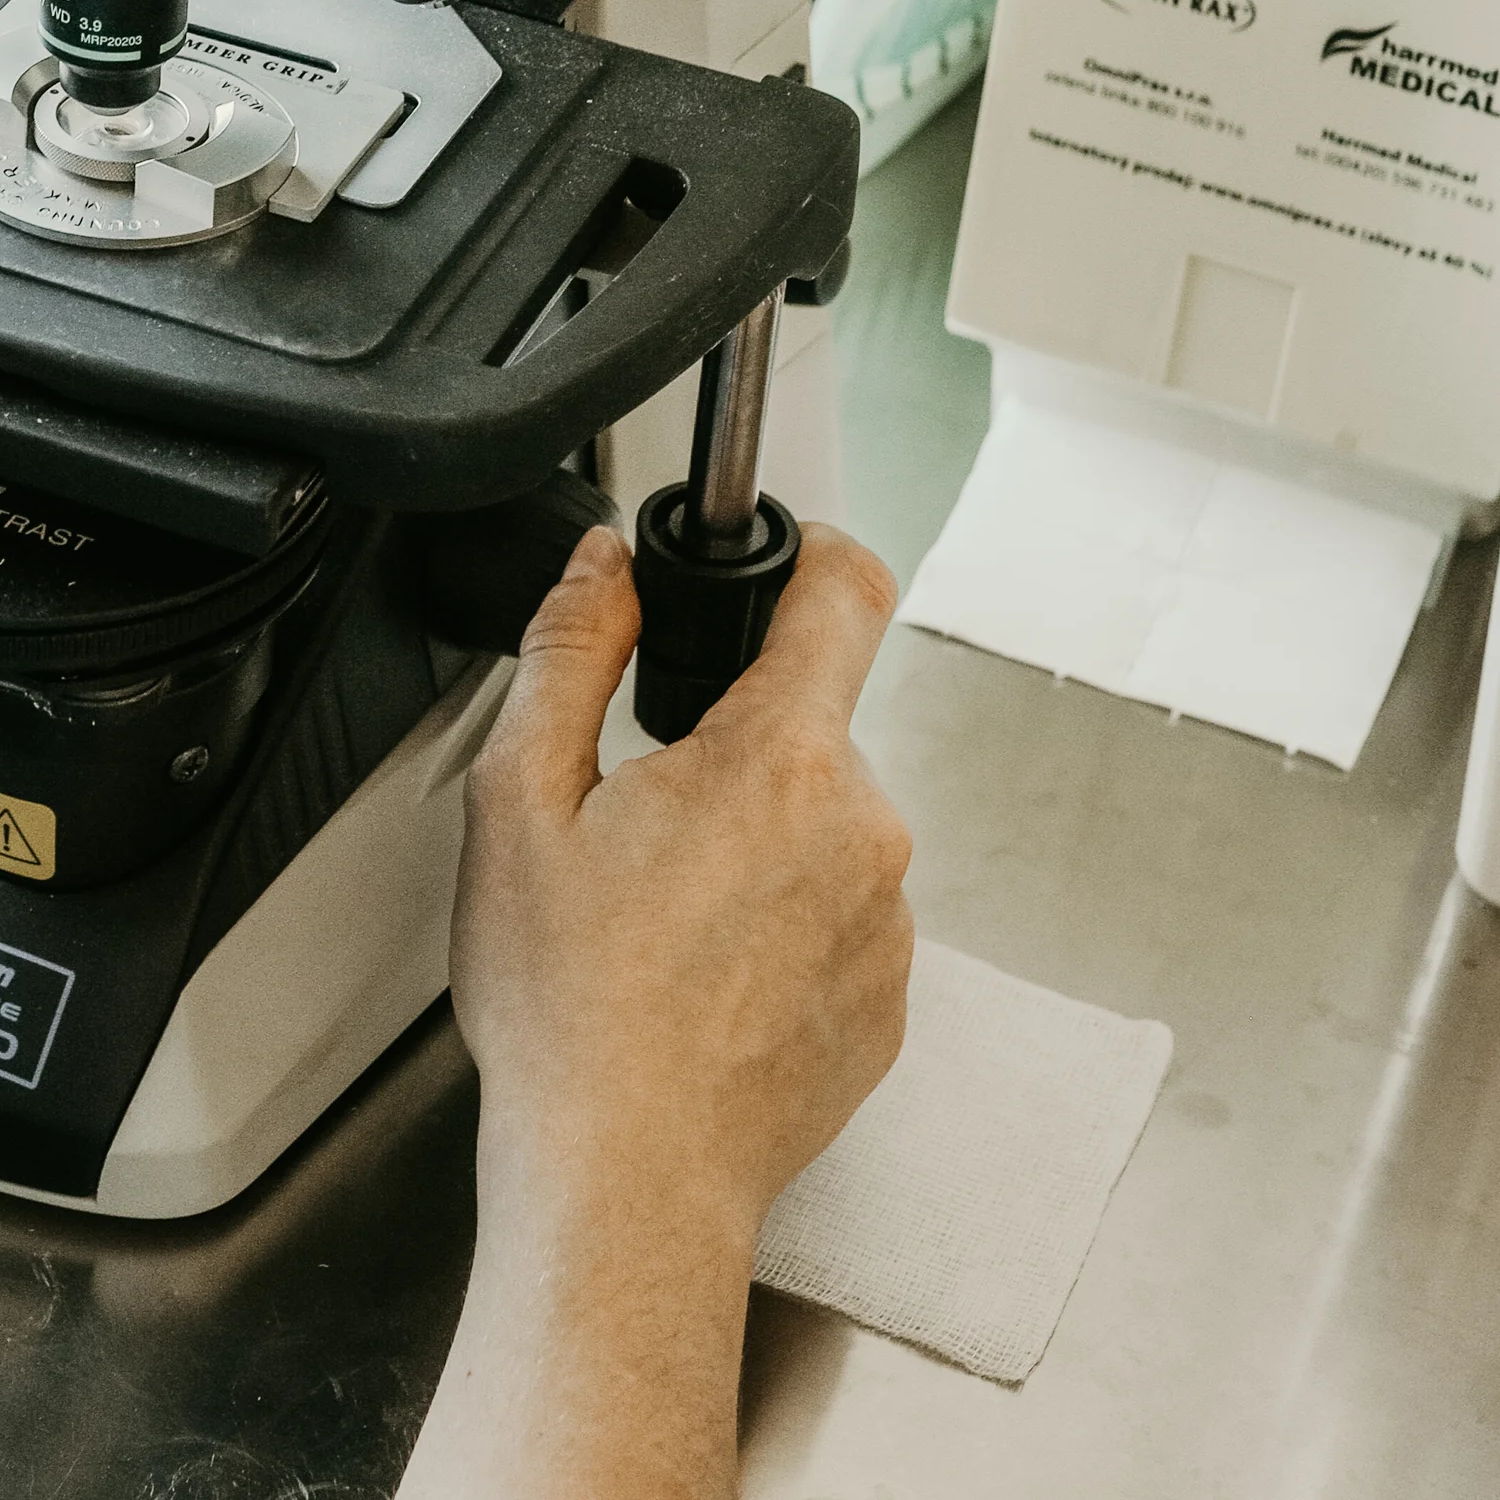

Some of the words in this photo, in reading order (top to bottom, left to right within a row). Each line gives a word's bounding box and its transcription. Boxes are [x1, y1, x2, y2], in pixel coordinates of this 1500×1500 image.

[50, 2, 71, 24] WD
[79, 17, 103, 32] 3.9
[80, 33, 143, 47] MRP20203
[184, 38, 252, 65] MBER
[262, 60, 325, 84] GRIP
[1380, 36, 1499, 86] harrmed
[1350, 55, 1500, 118] MEDICAL
